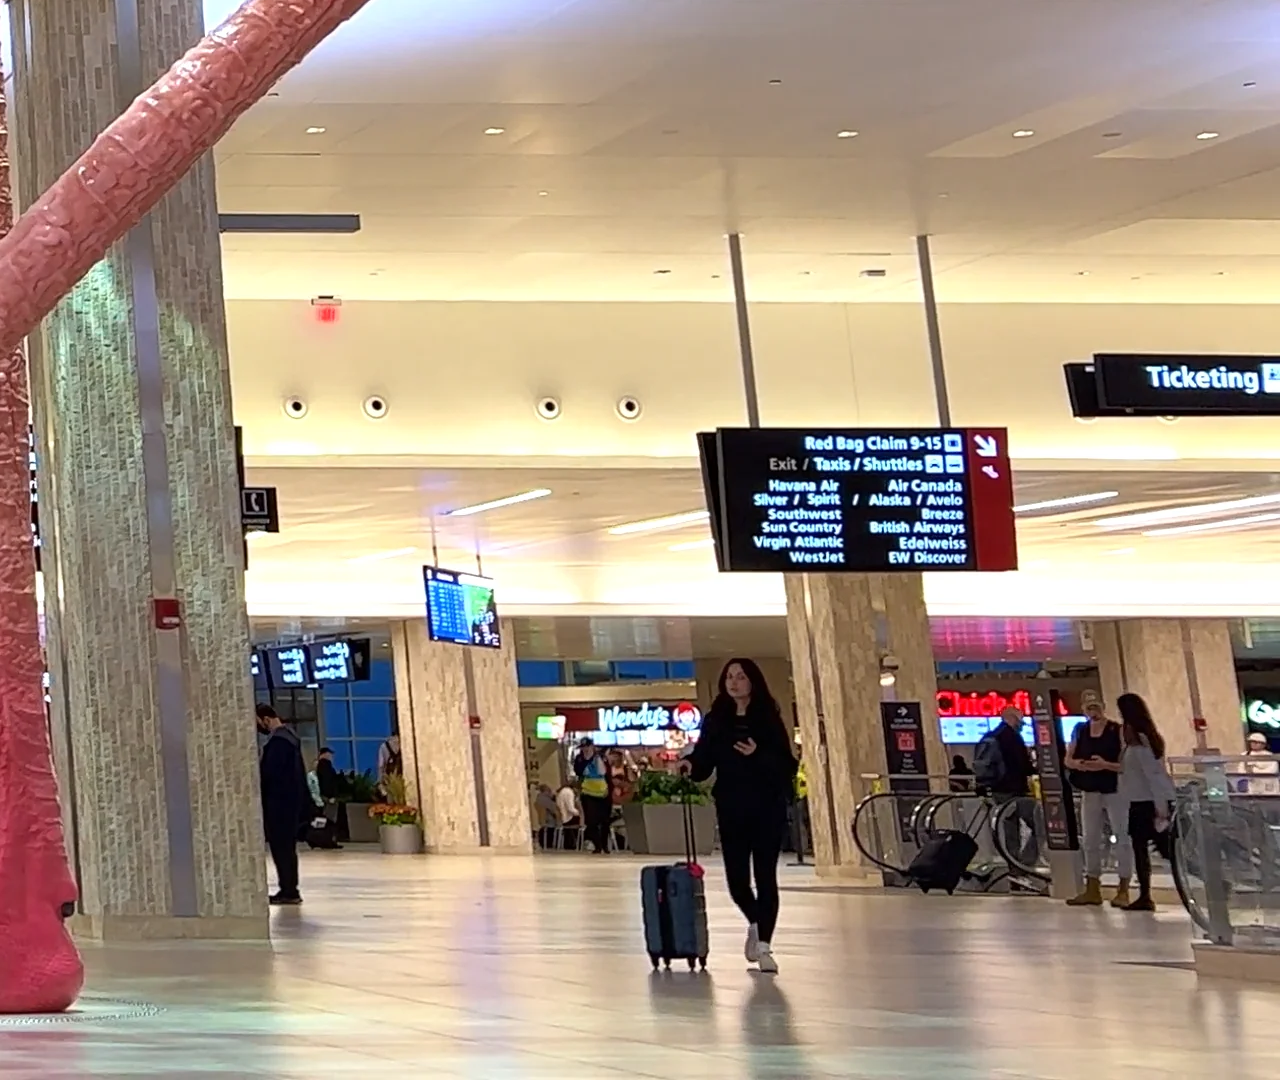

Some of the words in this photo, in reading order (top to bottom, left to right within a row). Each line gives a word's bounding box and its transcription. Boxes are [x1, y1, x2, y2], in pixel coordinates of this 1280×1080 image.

[1145, 365, 1260, 394] Ticketing
[805, 436, 833, 450] Red
[836, 436, 864, 453] Bag
[866, 436, 907, 450] Claim
[910, 436, 942, 450] 9-15
[769, 457, 797, 471] Exit
[814, 457, 851, 471] Taxis
[863, 457, 924, 471] Shuttles
[768, 480, 816, 492] Havana
[820, 479, 840, 492] Air
[888, 479, 909, 492] Air
[911, 479, 963, 492] Canada
[753, 494, 788, 506] Silver
[807, 493, 841, 508] Spirit
[869, 494, 911, 506] Alaska
[926, 494, 963, 506] Avelo
[768, 508, 842, 520] Southwest
[921, 508, 964, 520] Breeze
[762, 522, 787, 533] Sun
[789, 522, 842, 536] Country
[869, 522, 910, 534] British
[913, 521, 965, 536] Airways
[753, 535, 791, 550] Virgin
[794, 536, 843, 548] Atlantic
[899, 537, 967, 550] Edelweiss
[789, 551, 845, 563] WestJet
[888, 552, 910, 563] EW
[914, 552, 966, 564] Discover
[598, 702, 670, 731] Wendy's
